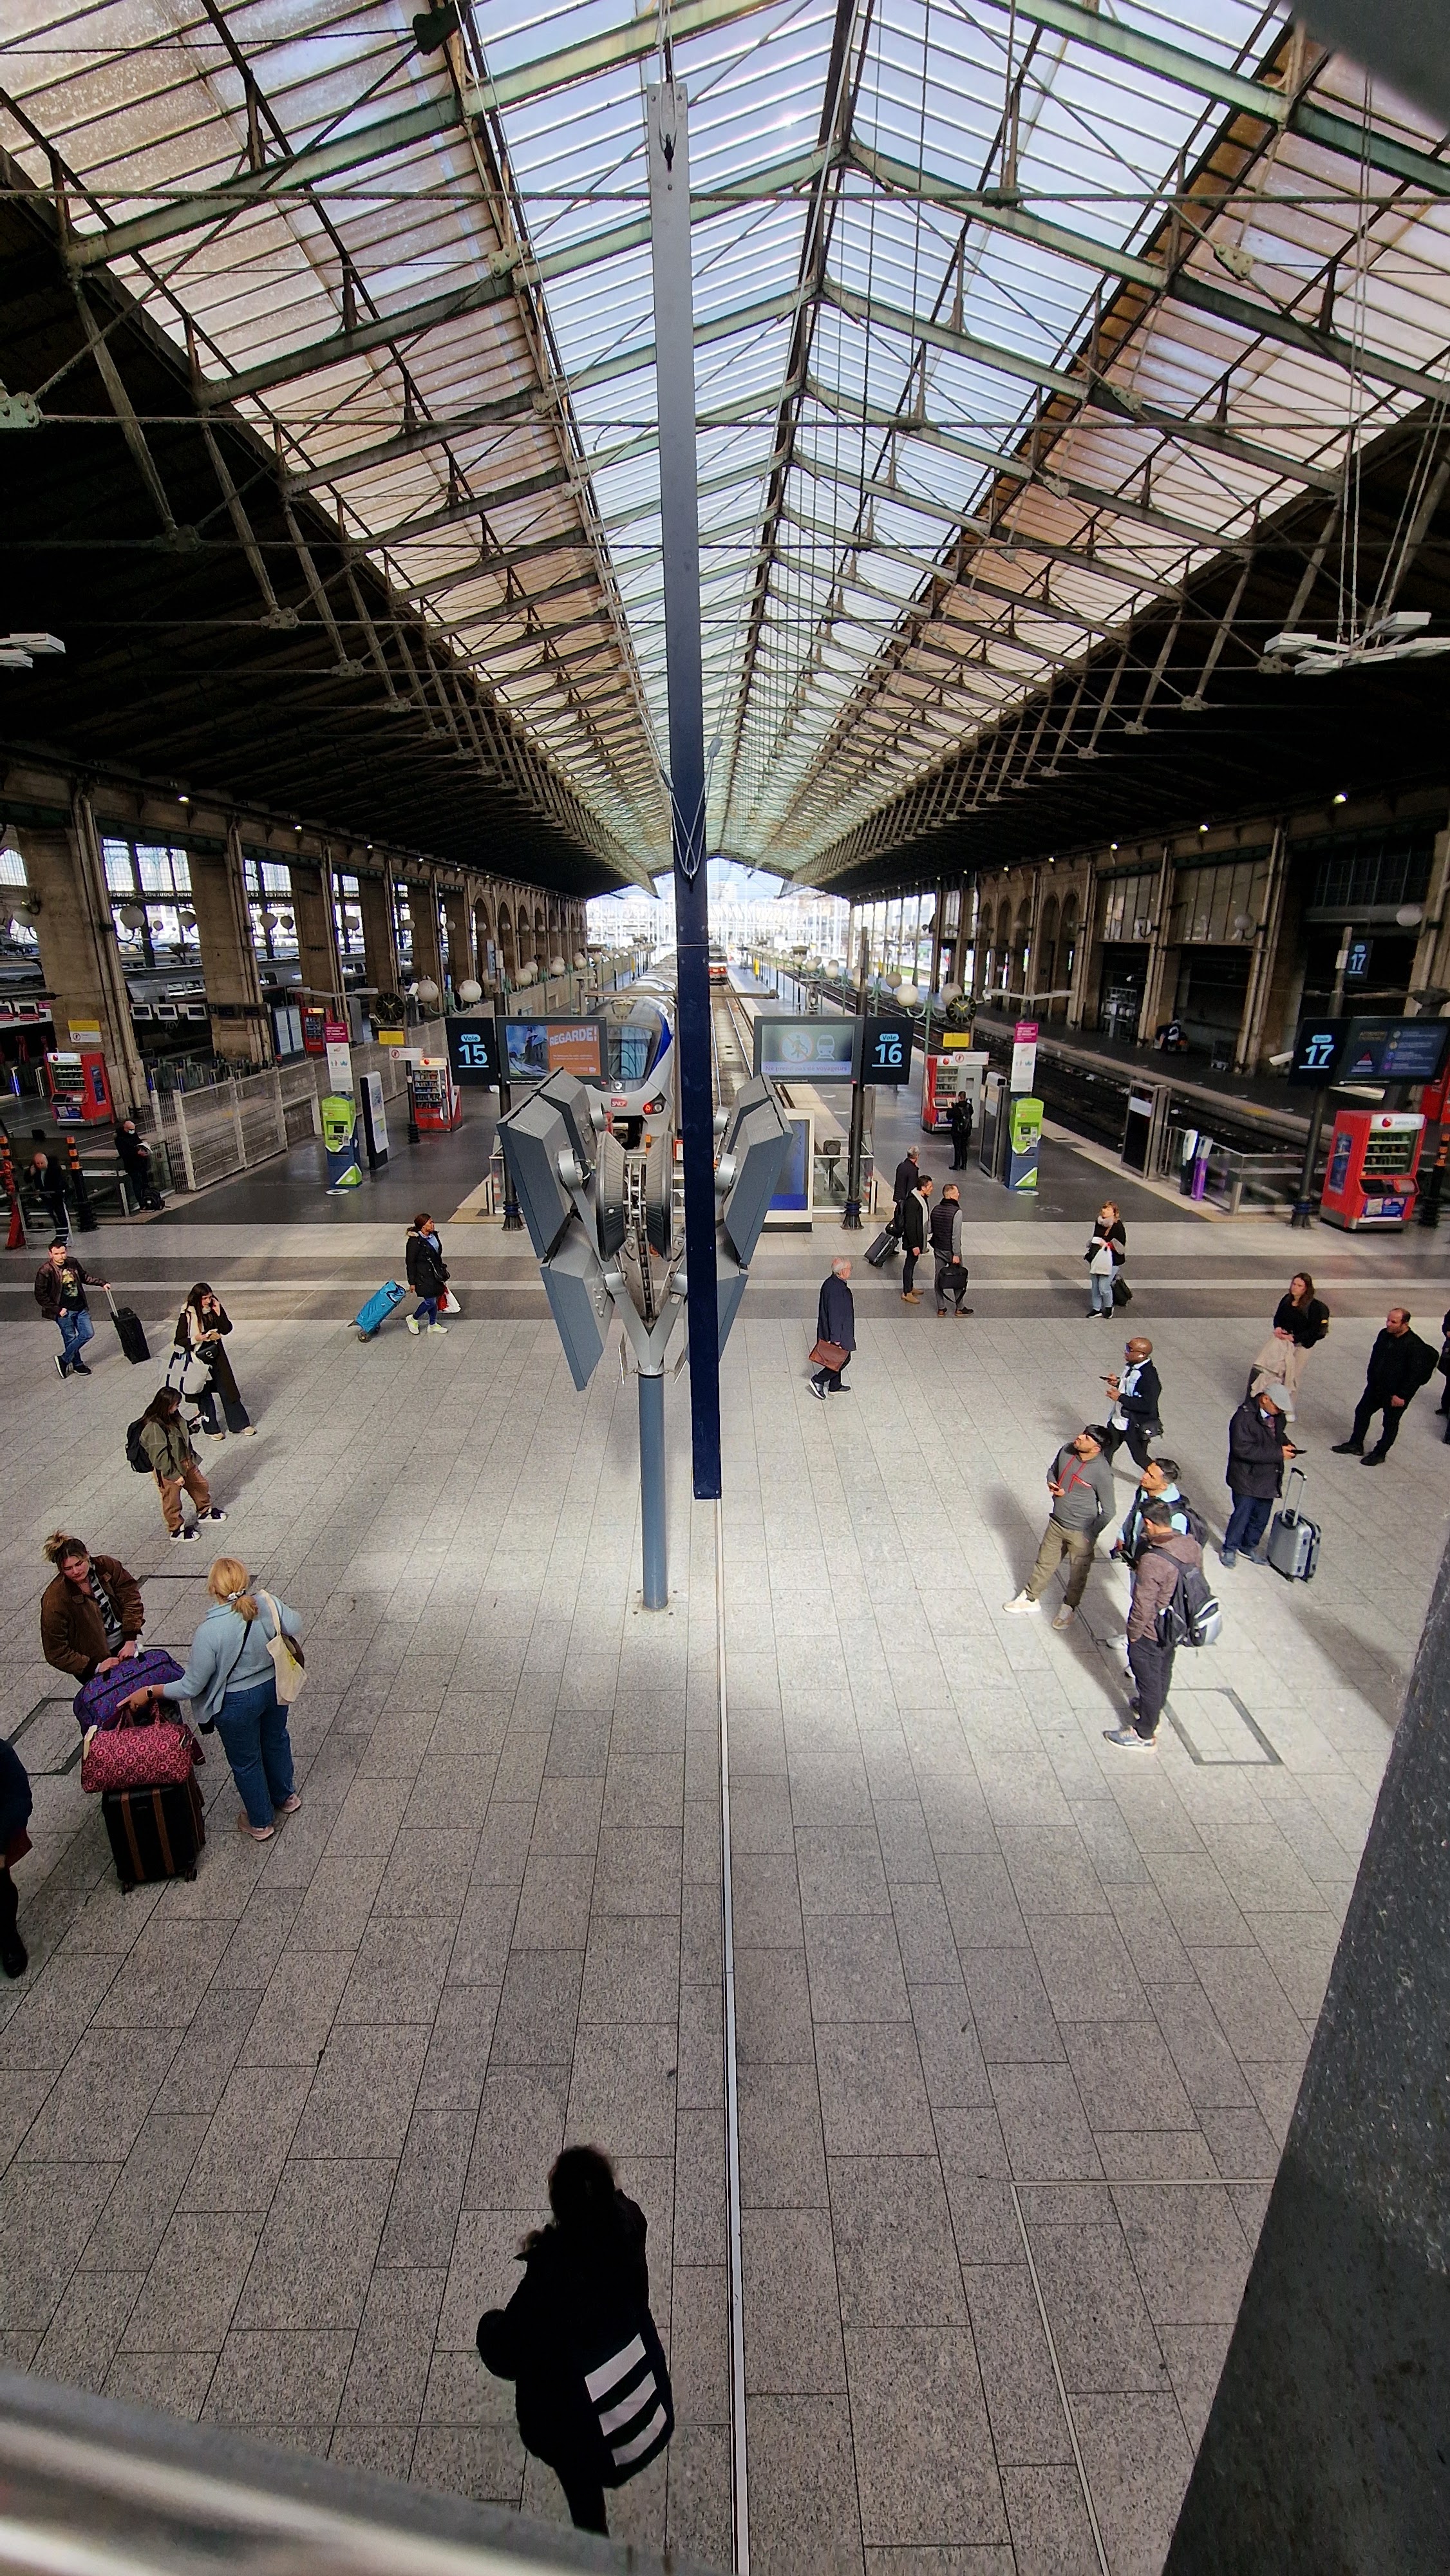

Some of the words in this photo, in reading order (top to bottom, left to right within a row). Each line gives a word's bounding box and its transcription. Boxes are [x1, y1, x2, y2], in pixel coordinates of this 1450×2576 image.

[1351, 954, 1366, 971] 17
[164, 1019, 180, 1030] TGV
[549, 1027, 598, 1047] REGARDE!
[458, 1044, 487, 1064] 15
[874, 1043, 902, 1063] 16
[1305, 1045, 1335, 1065] 17
